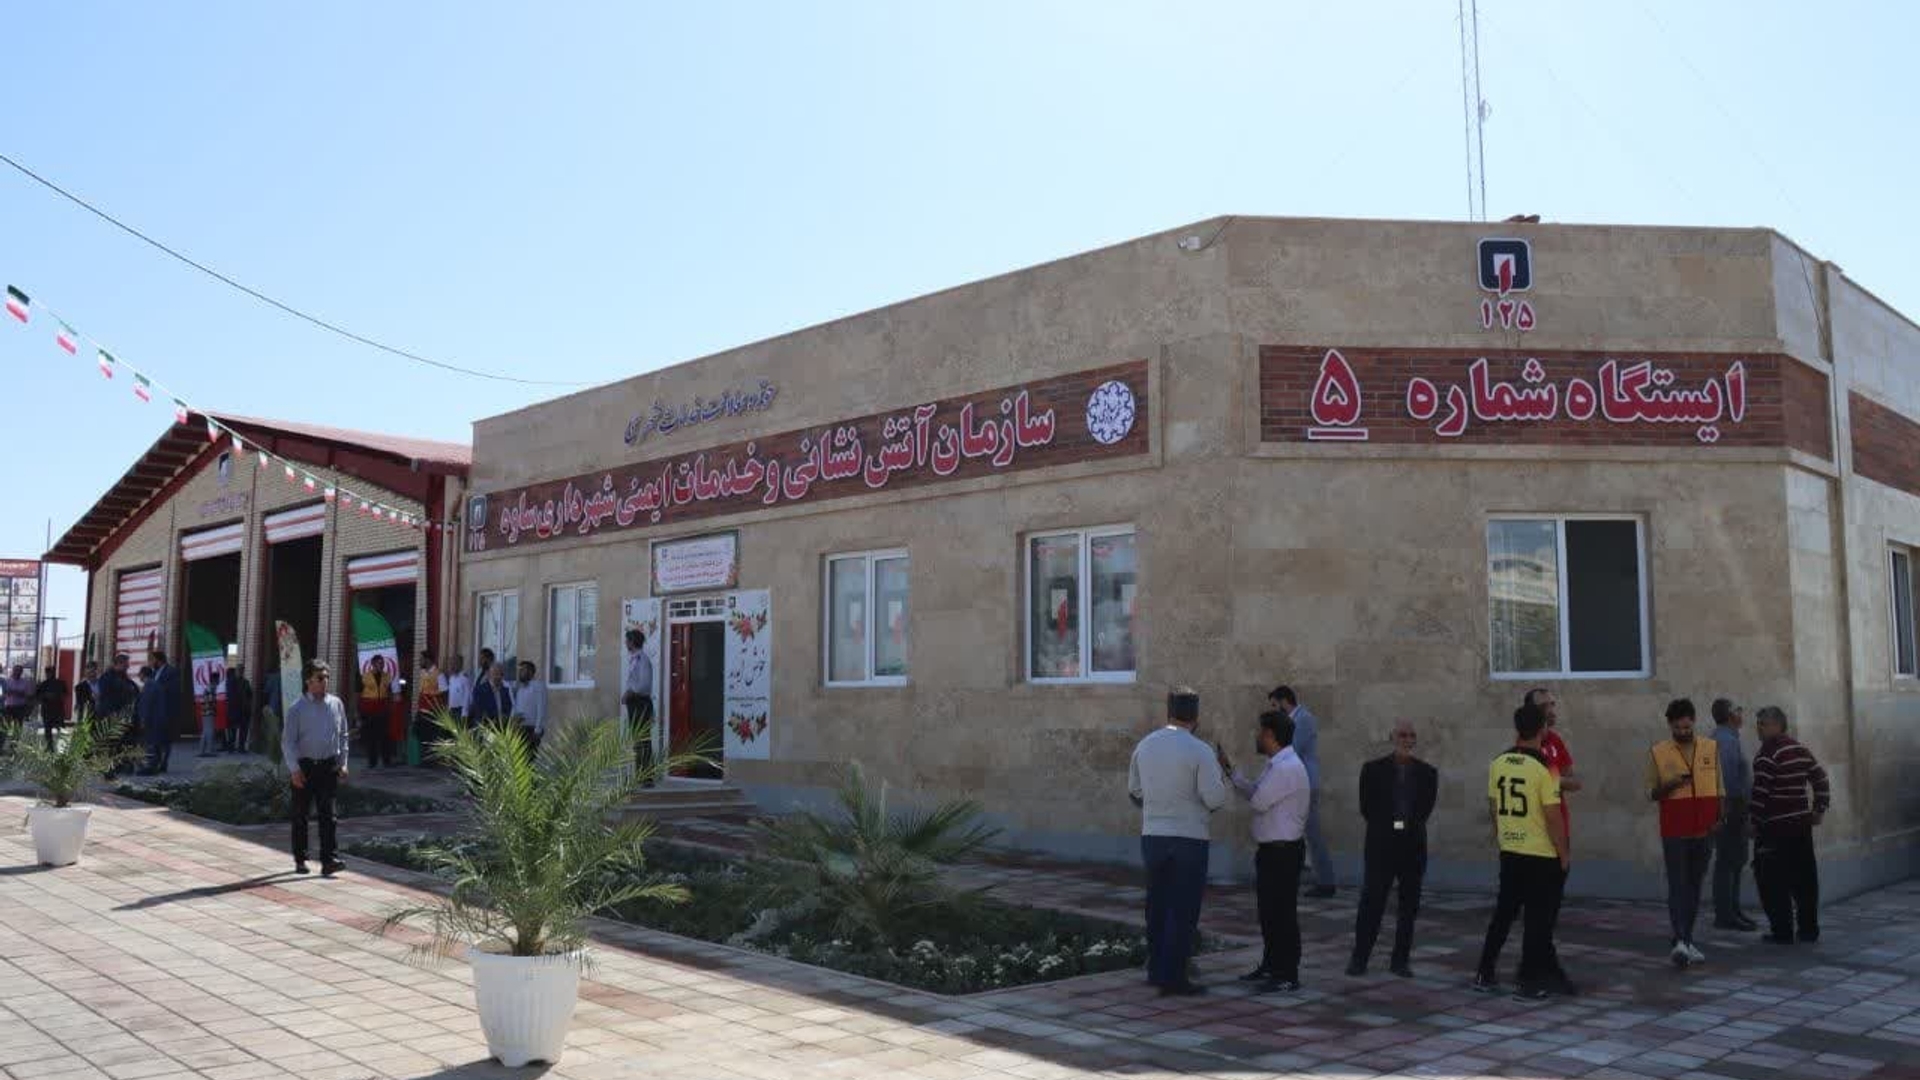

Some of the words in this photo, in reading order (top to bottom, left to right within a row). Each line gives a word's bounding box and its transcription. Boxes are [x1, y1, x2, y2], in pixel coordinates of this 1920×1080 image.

[1481, 298, 1536, 331] ۱۲۵
[1311, 348, 1362, 426] ۵
[1406, 357, 1558, 437] شماره
[1565, 359, 1746, 442] ایستگاه
[783, 427, 863, 499] نشانی
[864, 403, 937, 487] آتش
[932, 390, 1055, 475] سازمان
[536, 473, 617, 539] شهرداری
[616, 462, 672, 526] ایمنی
[672, 442, 765, 504] خدمات
[763, 459, 780, 504] و
[501, 490, 539, 544] ساوه
[1497, 776, 1528, 818] 15
